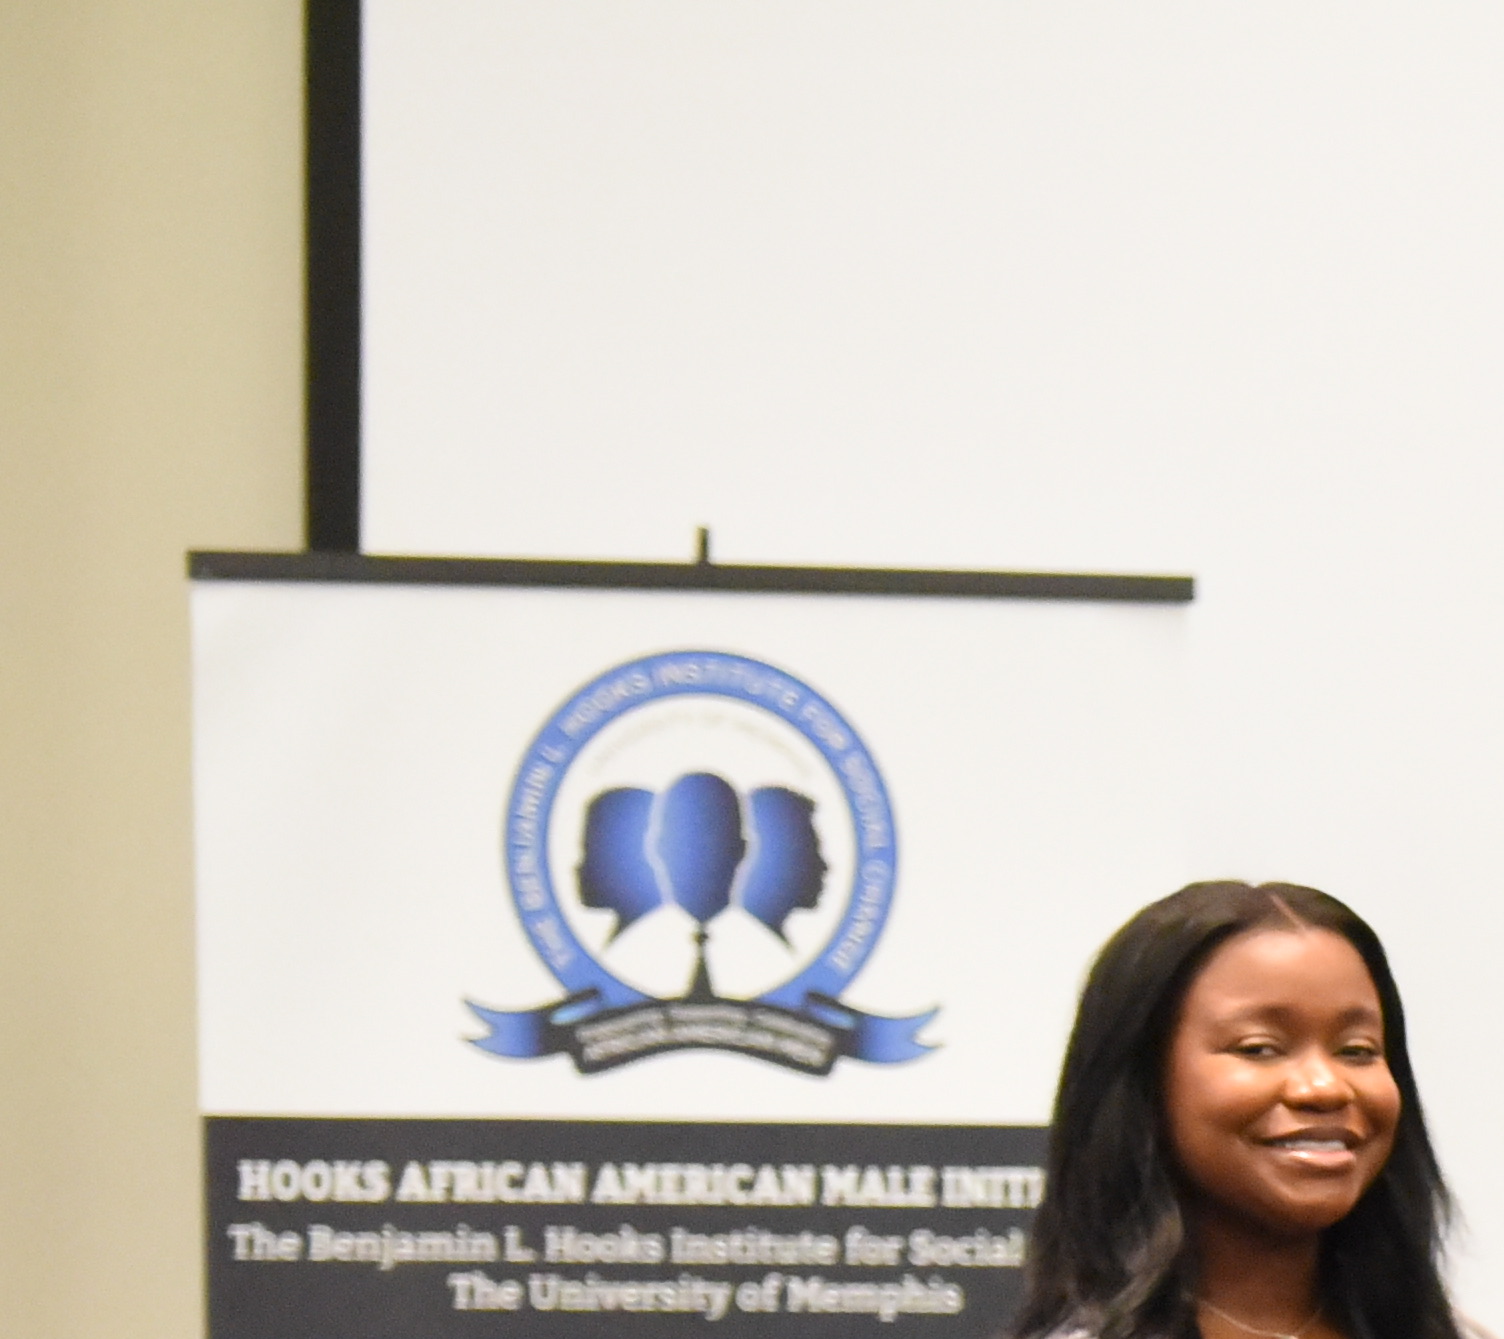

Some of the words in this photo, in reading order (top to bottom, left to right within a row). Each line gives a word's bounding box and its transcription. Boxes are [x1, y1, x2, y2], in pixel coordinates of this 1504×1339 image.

[236, 1158, 391, 1202] HOOKS
[396, 1159, 589, 1204] AFRICAN
[590, 1161, 818, 1206] AMERICAN
[821, 1164, 938, 1208] MALE
[227, 1221, 303, 1262] The
[307, 1221, 498, 1271] Benjamin
[503, 1224, 537, 1263] L.
[543, 1223, 666, 1264] Hooks
[669, 1225, 840, 1266] Institute
[844, 1224, 904, 1266] for
[907, 1227, 1028, 1268] Social
[446, 1269, 524, 1311] The
[527, 1271, 733, 1321] University
[735, 1271, 783, 1312] of
[785, 1273, 964, 1323] Memphis
